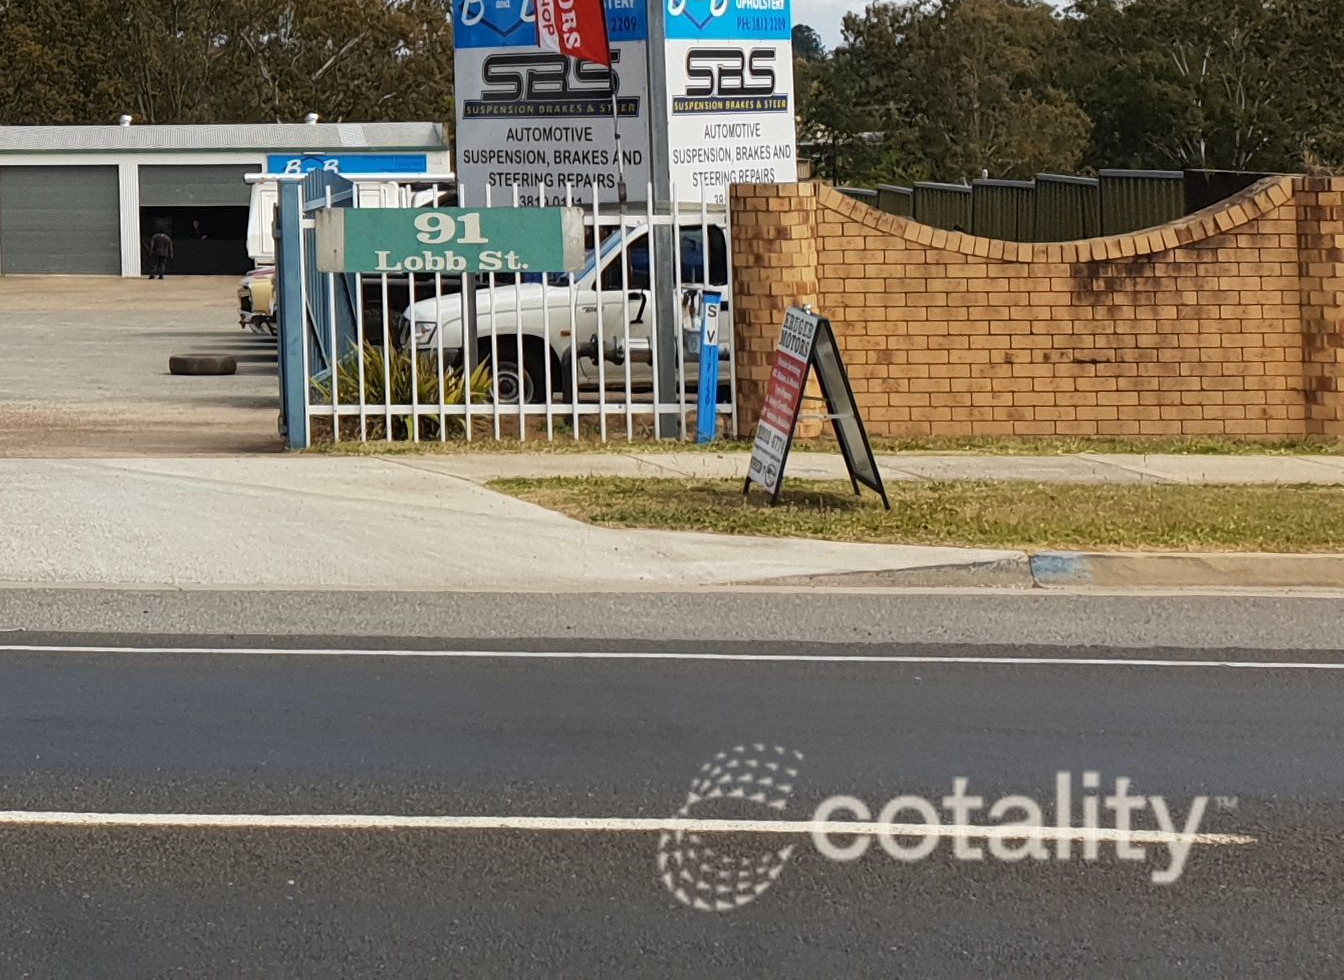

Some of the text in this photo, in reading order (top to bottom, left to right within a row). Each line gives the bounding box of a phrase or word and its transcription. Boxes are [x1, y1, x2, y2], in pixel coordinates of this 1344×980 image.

[685, 47, 776, 97] SBS
[466, 103, 534, 115] SUSPENSION
[538, 103, 582, 114] BRAKES
[600, 102, 636, 113] STER
[674, 101, 723, 111] SUSPENSION
[725, 100, 754, 110] BRAKES
[763, 99, 786, 109] STEER
[506, 126, 593, 142] AUTOMOTIVE
[704, 123, 761, 140] AUTOMOTIVE
[463, 149, 642, 167] SUSPENSION, BRAKES AND
[673, 145, 791, 165] SUSPENSION, BRAKES AND
[488, 172, 615, 188] STEERING REPAIRS
[692, 168, 775, 187] STEERING REPAIRS
[413, 212, 489, 244] 91
[374, 250, 529, 271] Lobb St.
[708, 305, 717, 317] S
[707, 330, 716, 343] V
[779, 329, 811, 358] MOTORS
